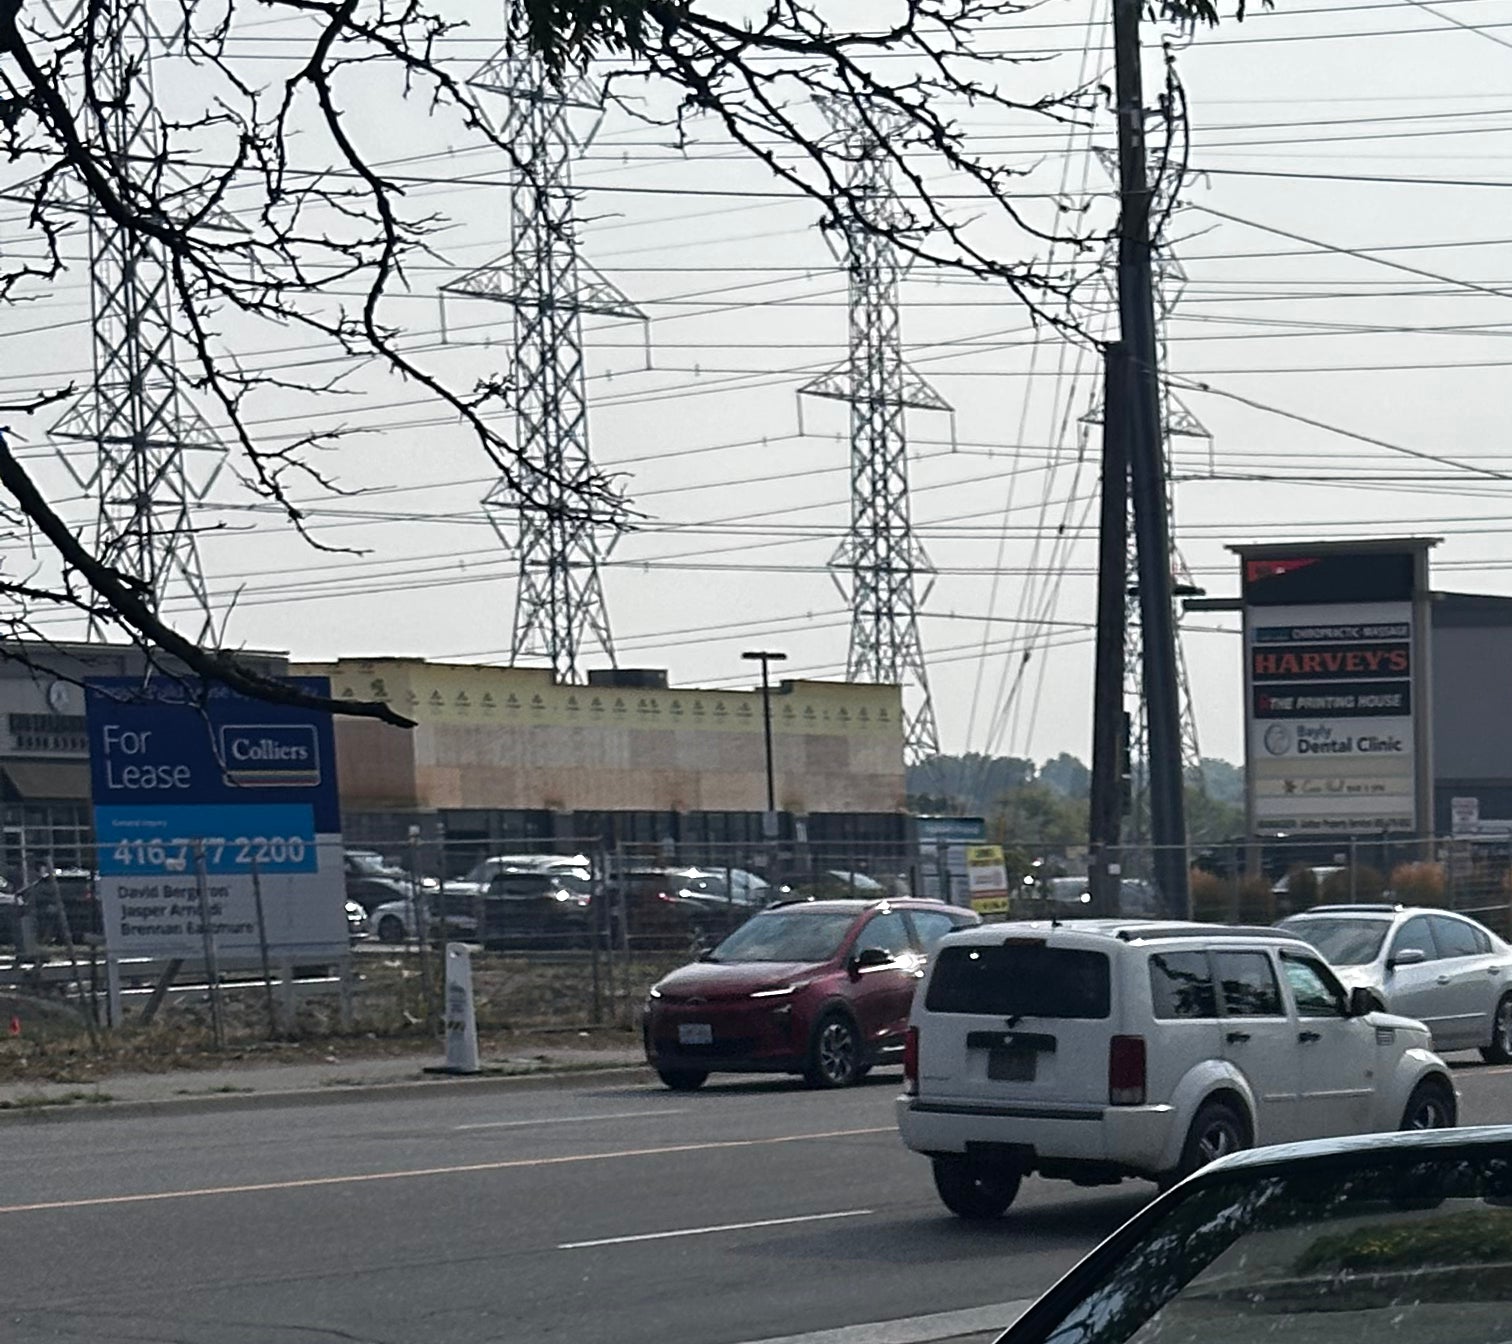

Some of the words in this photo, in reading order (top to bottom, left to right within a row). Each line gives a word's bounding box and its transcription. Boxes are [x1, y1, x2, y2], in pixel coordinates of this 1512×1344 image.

[1254, 650, 1409, 674] HARVEY'S
[1270, 697, 1294, 710] THE
[1296, 695, 1355, 709] PRINTING
[1357, 694, 1403, 707] HOUSE
[103, 725, 152, 754] For
[1296, 725, 1332, 740] Bayly
[231, 738, 309, 760] Colliers
[1297, 738, 1352, 754] Dental
[1357, 736, 1402, 752] Clinic
[106, 760, 191, 788] Lease
[113, 838, 165, 865] 416
[235, 836, 305, 864] 2200
[118, 886, 159, 898] David
[164, 886, 230, 901] Bergon
[121, 904, 166, 920] Jasper
[170, 903, 222, 916] Arndi
[121, 923, 183, 936] Brennan
